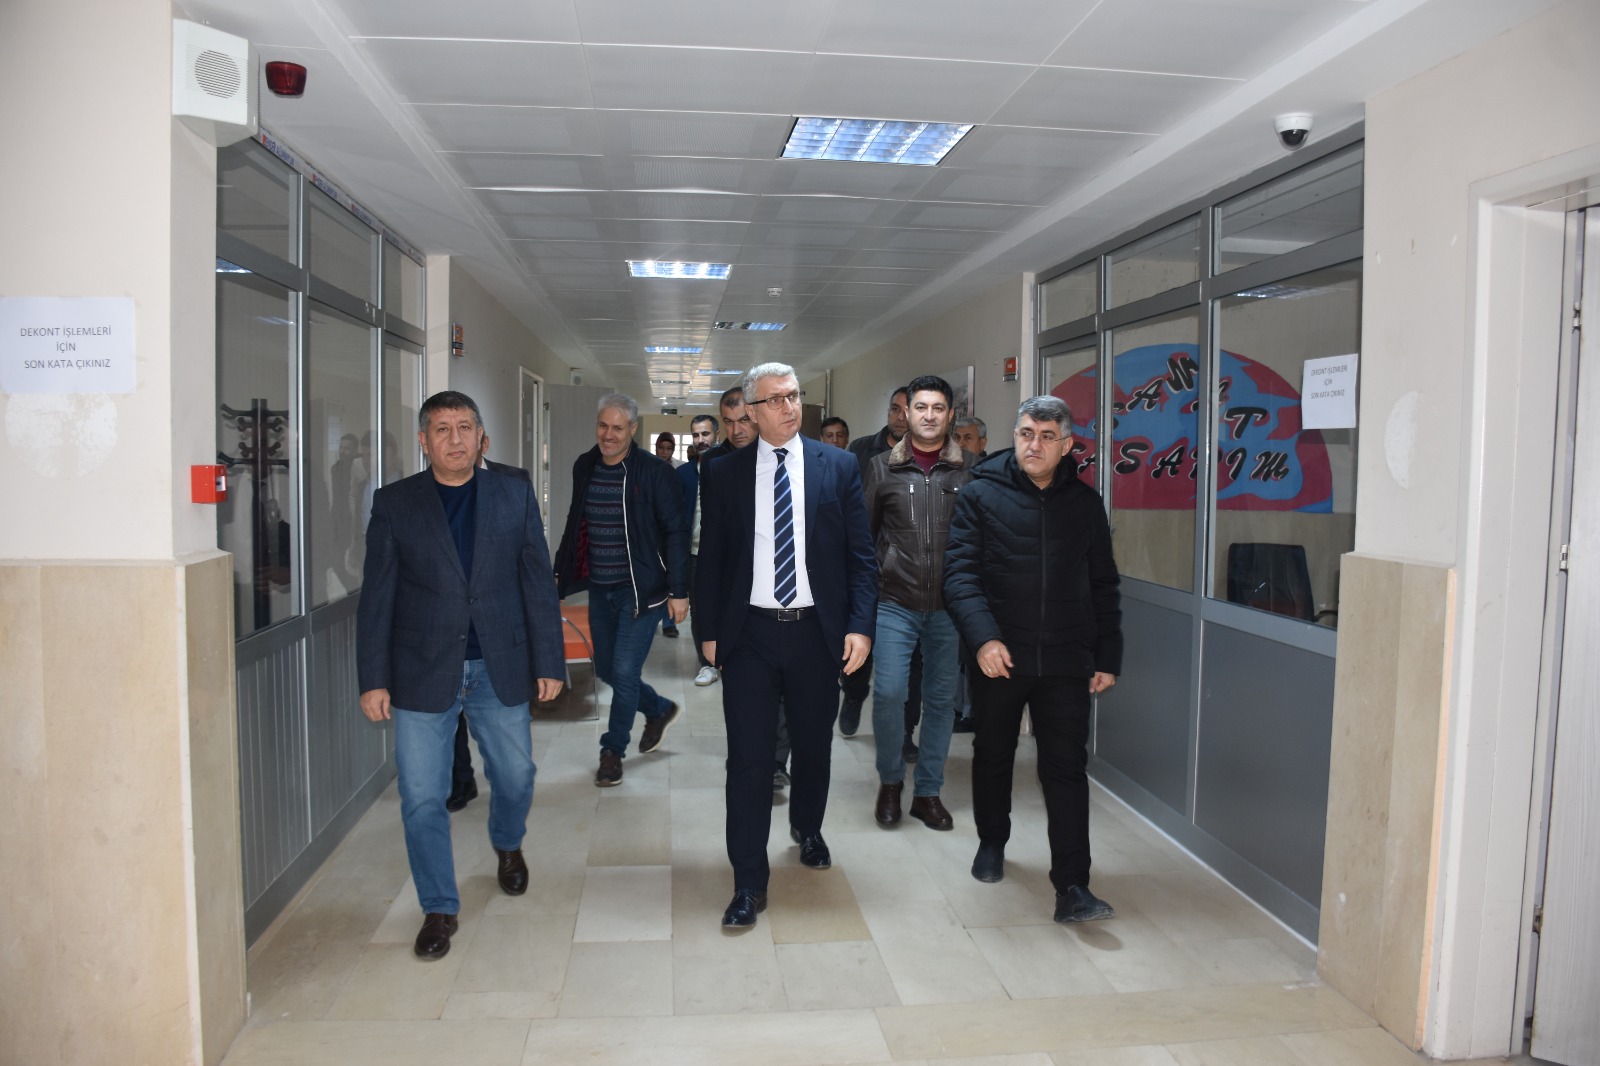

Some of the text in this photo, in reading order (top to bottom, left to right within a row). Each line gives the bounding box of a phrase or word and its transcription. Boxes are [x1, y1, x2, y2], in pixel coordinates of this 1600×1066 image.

[20, 325, 112, 338] DEKONT İŞLEMLERİ
[56, 341, 76, 353] İÇİN
[24, 359, 111, 369] SON KATA ÇIKINIZ
